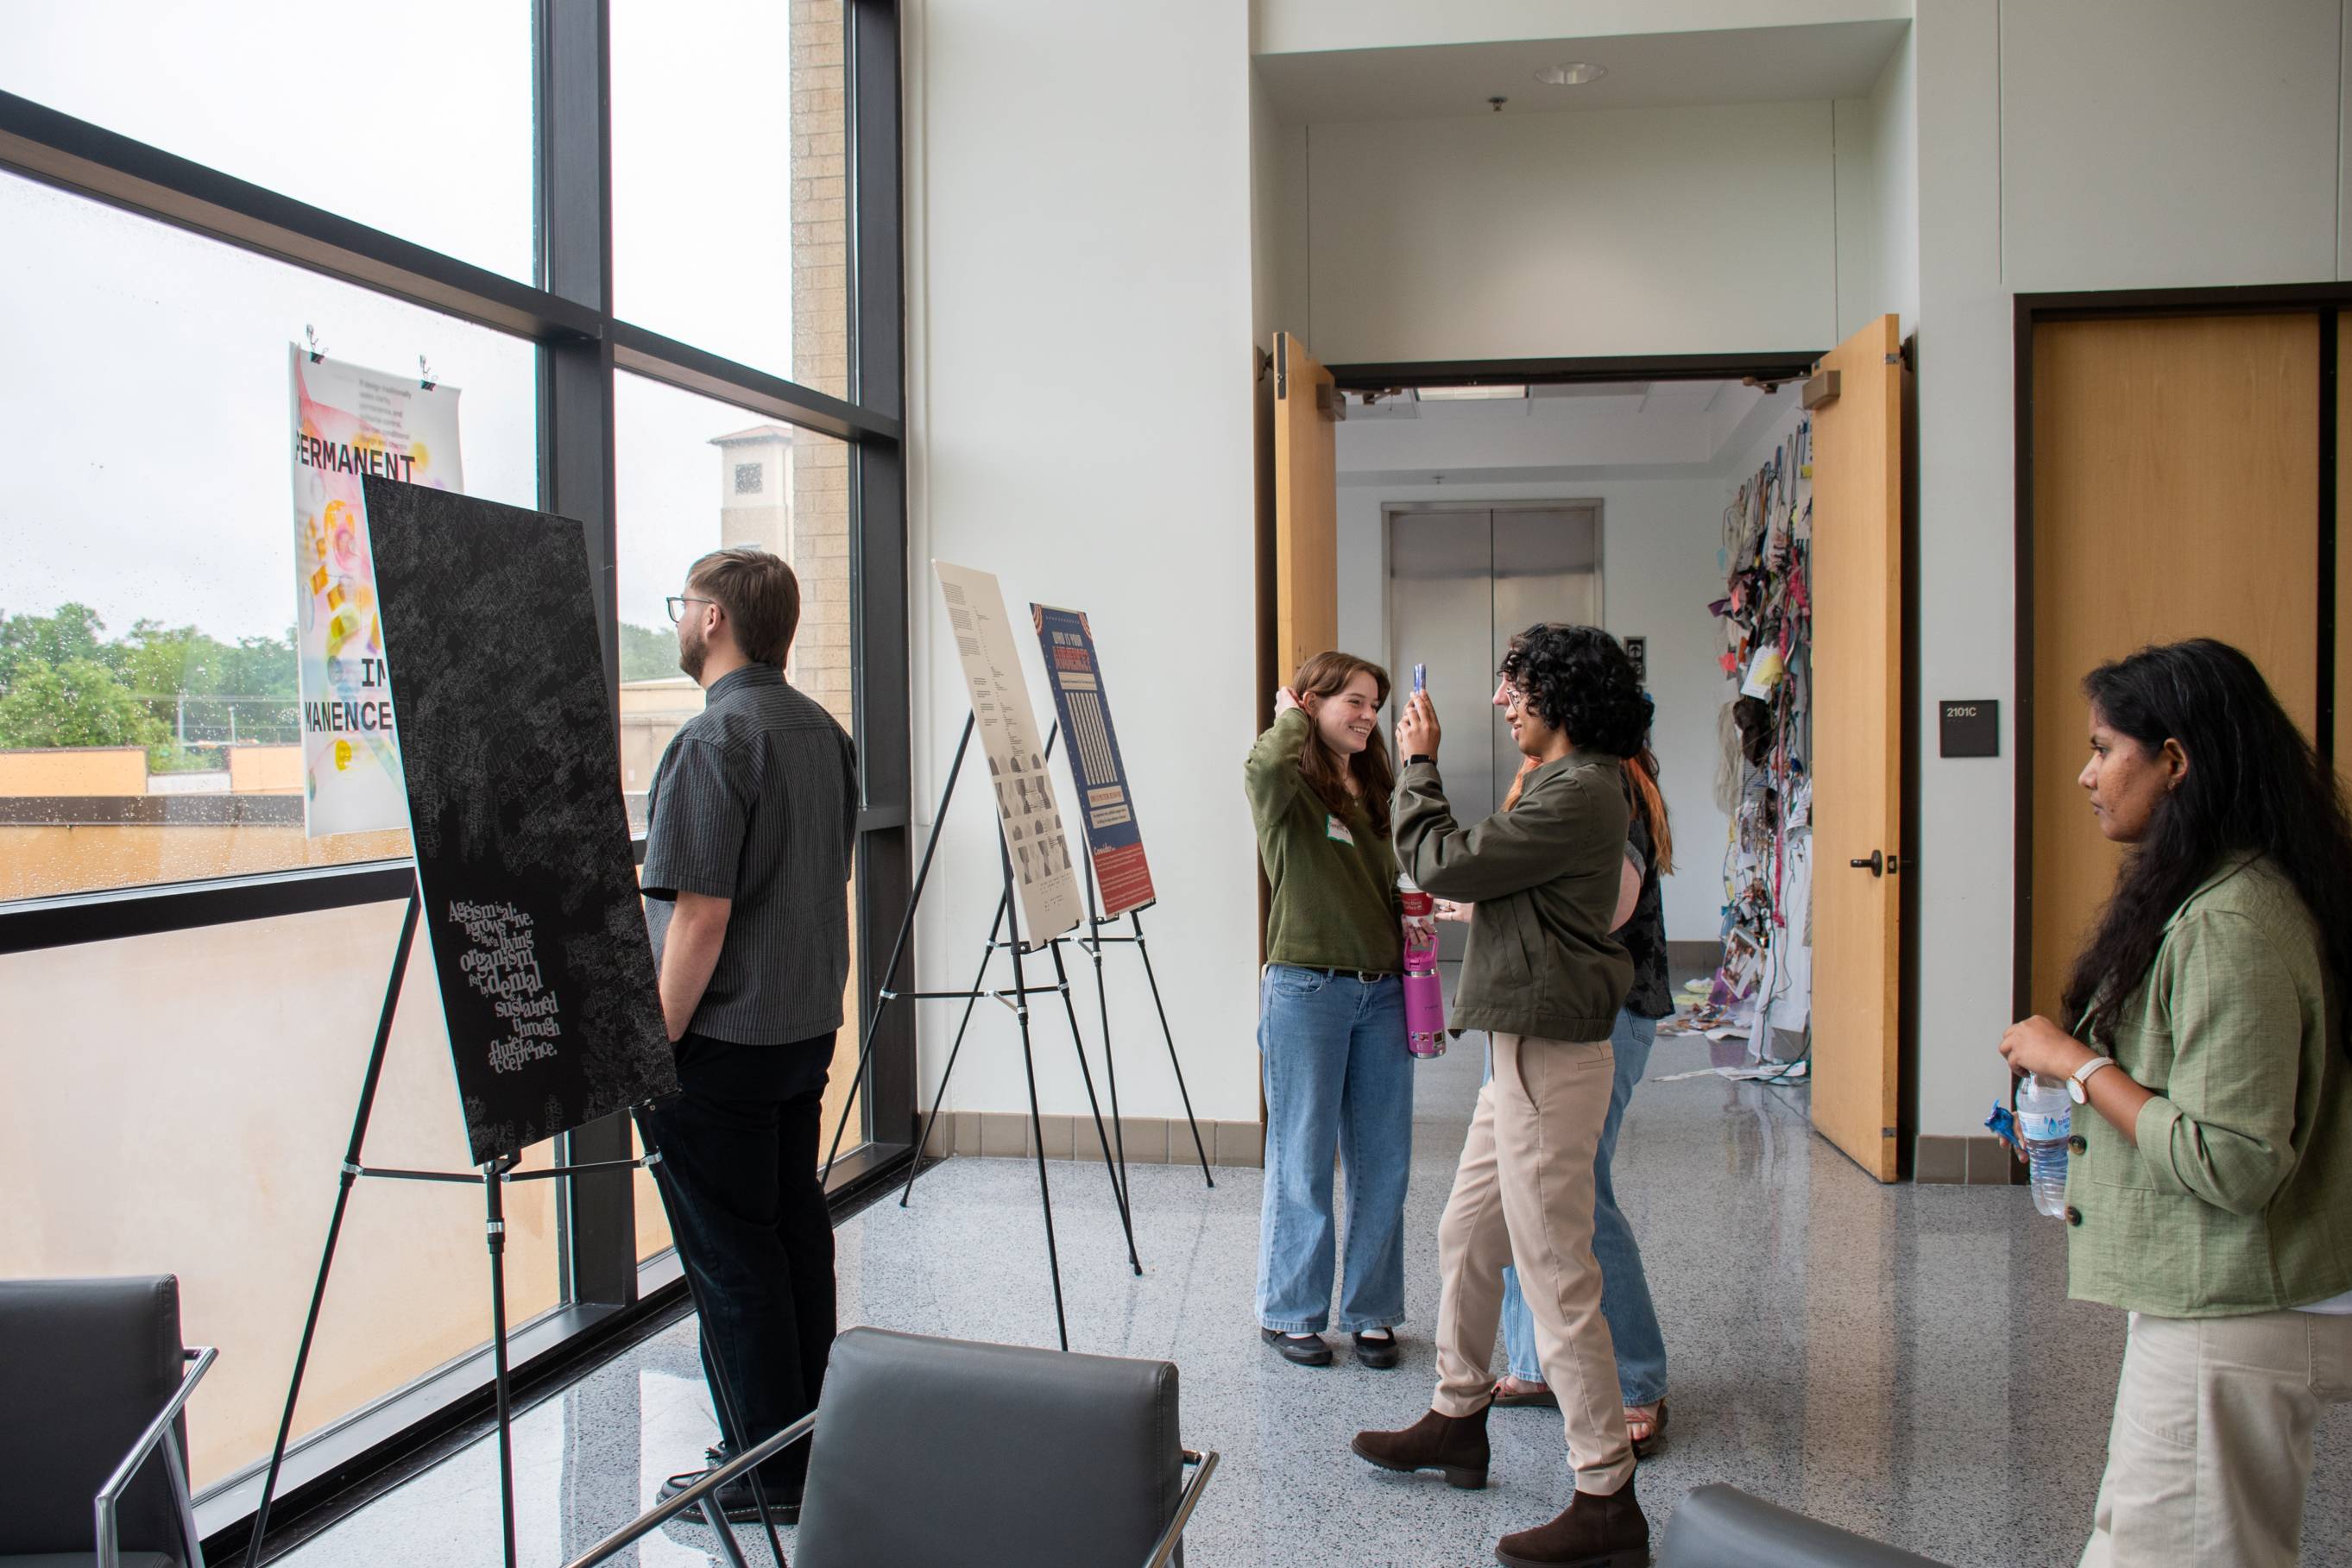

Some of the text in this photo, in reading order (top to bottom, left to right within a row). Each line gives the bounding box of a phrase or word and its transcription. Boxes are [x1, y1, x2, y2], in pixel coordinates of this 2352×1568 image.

[1946, 707, 1977, 717] 2101C
[448, 899, 498, 923] Ageism
[501, 901, 533, 929] alive.
[470, 918, 507, 942] grows
[499, 929, 535, 952] living
[460, 948, 535, 979] organism
[487, 960, 544, 999] denial
[495, 990, 560, 1018] sustained
[511, 1015, 562, 1038] through
[487, 1039, 558, 1074] acceptance.
[489, 1035, 525, 1061] quiet
